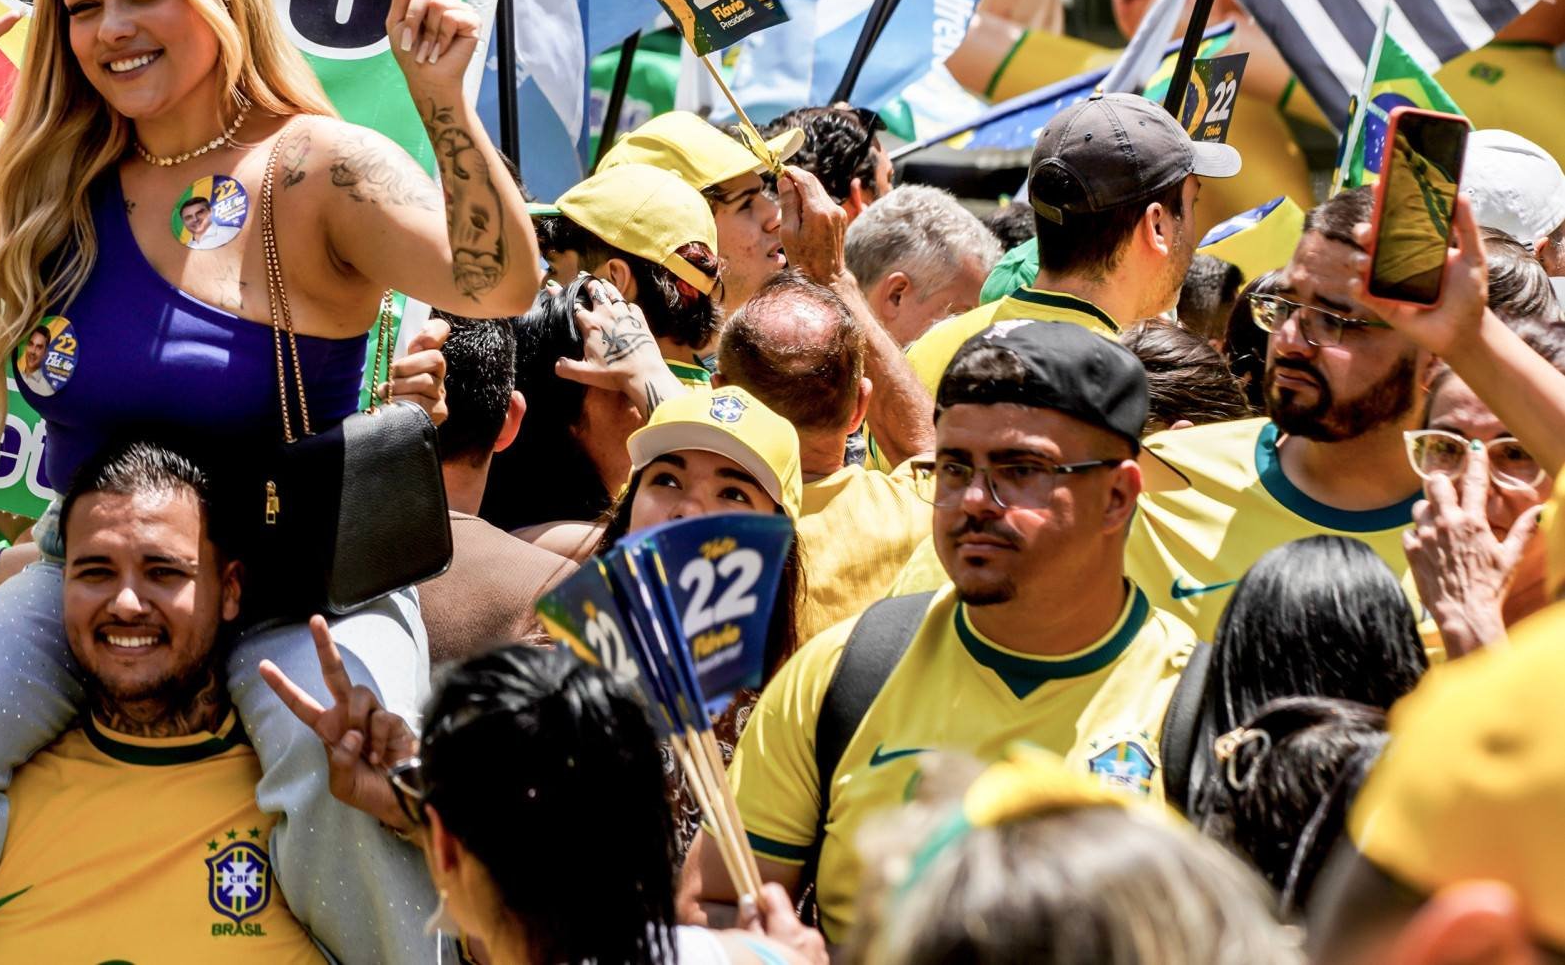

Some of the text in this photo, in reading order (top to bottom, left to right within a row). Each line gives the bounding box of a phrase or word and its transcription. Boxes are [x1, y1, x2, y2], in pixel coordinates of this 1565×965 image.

[1204, 78, 1237, 124] 22
[214, 179, 239, 203] 22
[54, 334, 78, 356] 22
[679, 548, 764, 638] 22
[229, 875, 250, 884] CBF
[211, 923, 267, 936] BRASIL
